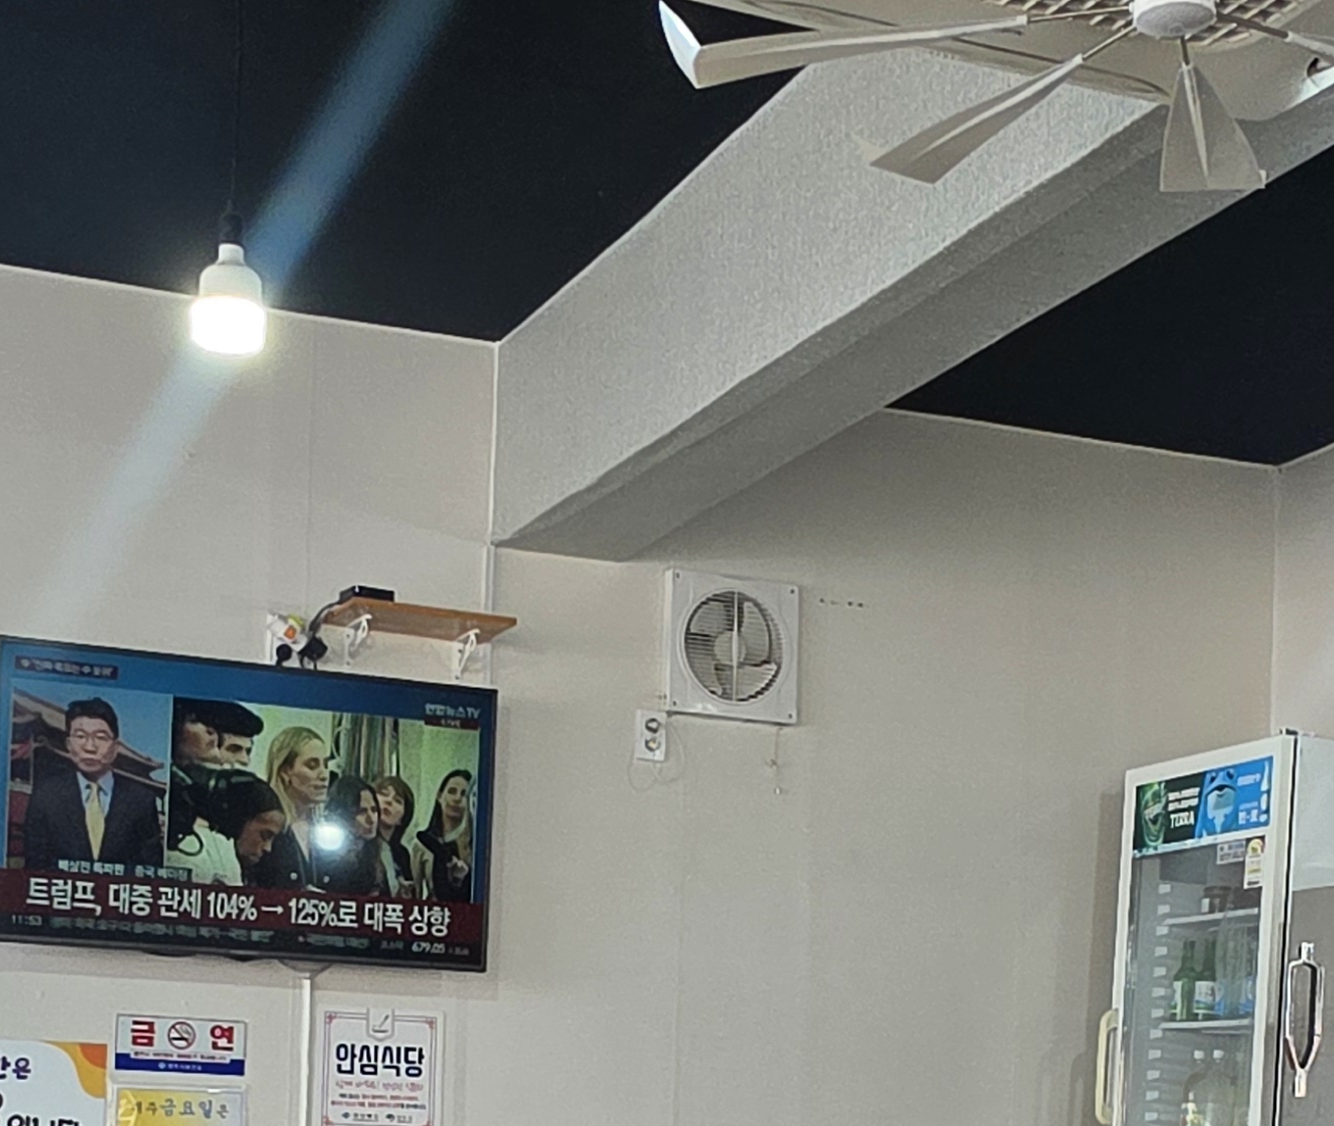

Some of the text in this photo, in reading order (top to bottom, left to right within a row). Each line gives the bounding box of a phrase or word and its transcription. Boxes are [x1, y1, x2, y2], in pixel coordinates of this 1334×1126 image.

[26, 876, 451, 938] 트럼프, 대중 관세 104% 125%로 대폭 상향
[335, 1043, 425, 1077] 안심식당
